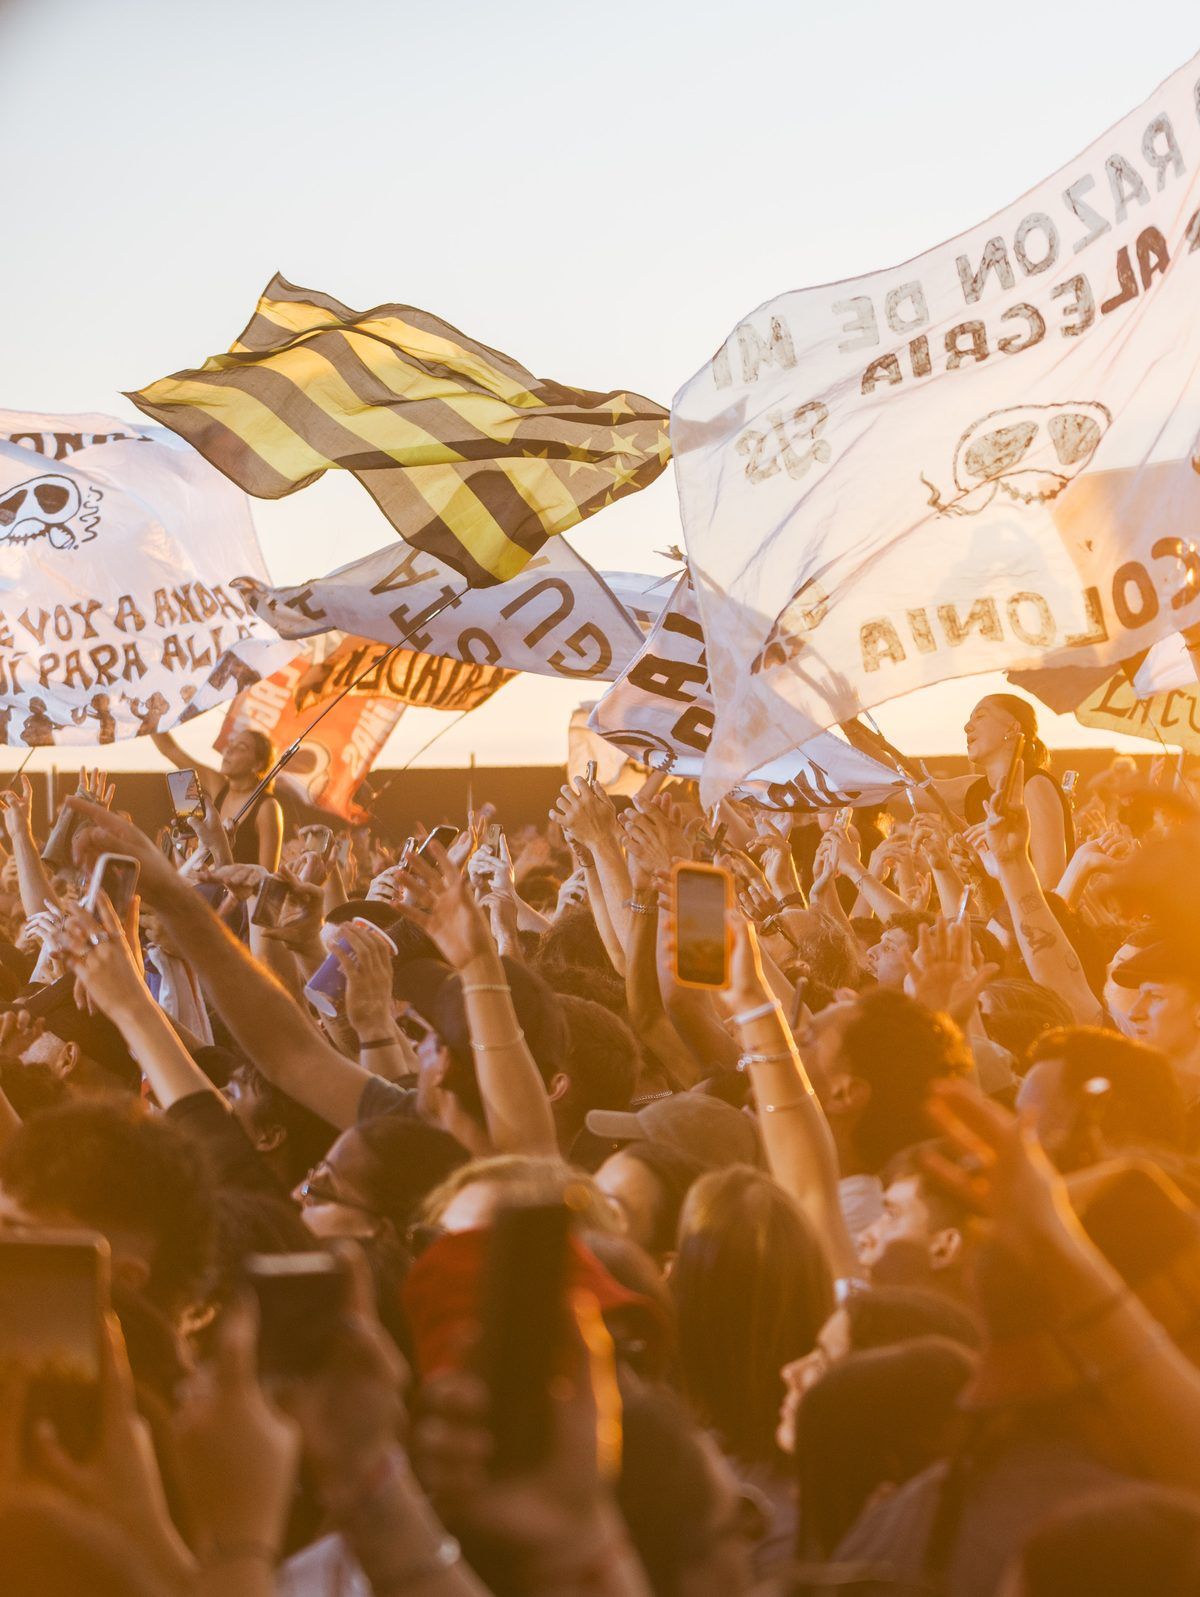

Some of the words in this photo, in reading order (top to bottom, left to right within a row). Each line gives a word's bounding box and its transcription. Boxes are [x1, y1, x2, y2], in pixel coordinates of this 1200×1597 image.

[17, 599, 103, 647] VOY
[113, 593, 147, 634] A
[153, 580, 255, 629] ANDA
[38, 642, 149, 692] PARA
